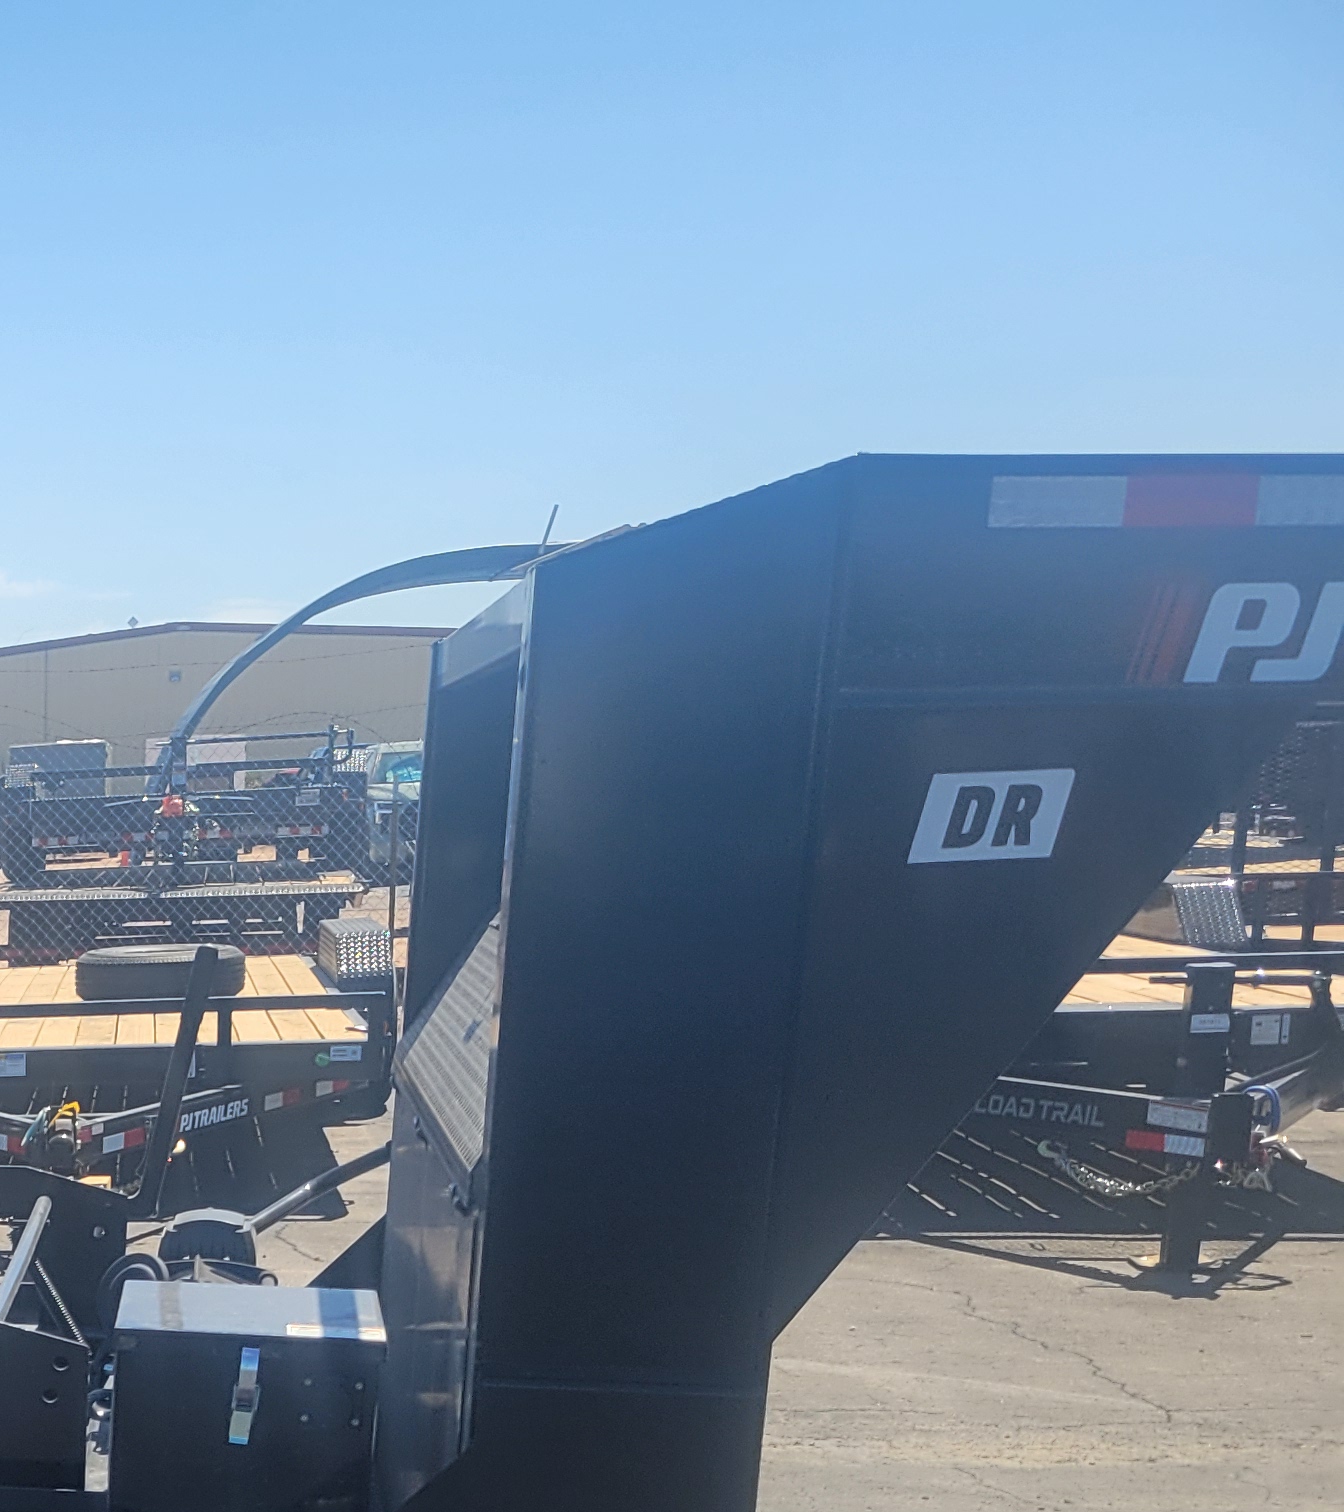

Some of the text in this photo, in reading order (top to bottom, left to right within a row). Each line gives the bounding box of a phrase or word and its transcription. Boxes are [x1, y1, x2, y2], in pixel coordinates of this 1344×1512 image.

[1183, 581, 1344, 683] PJ
[941, 784, 1043, 849] DR
[974, 1095, 1104, 1127] LOAD TRAIL
